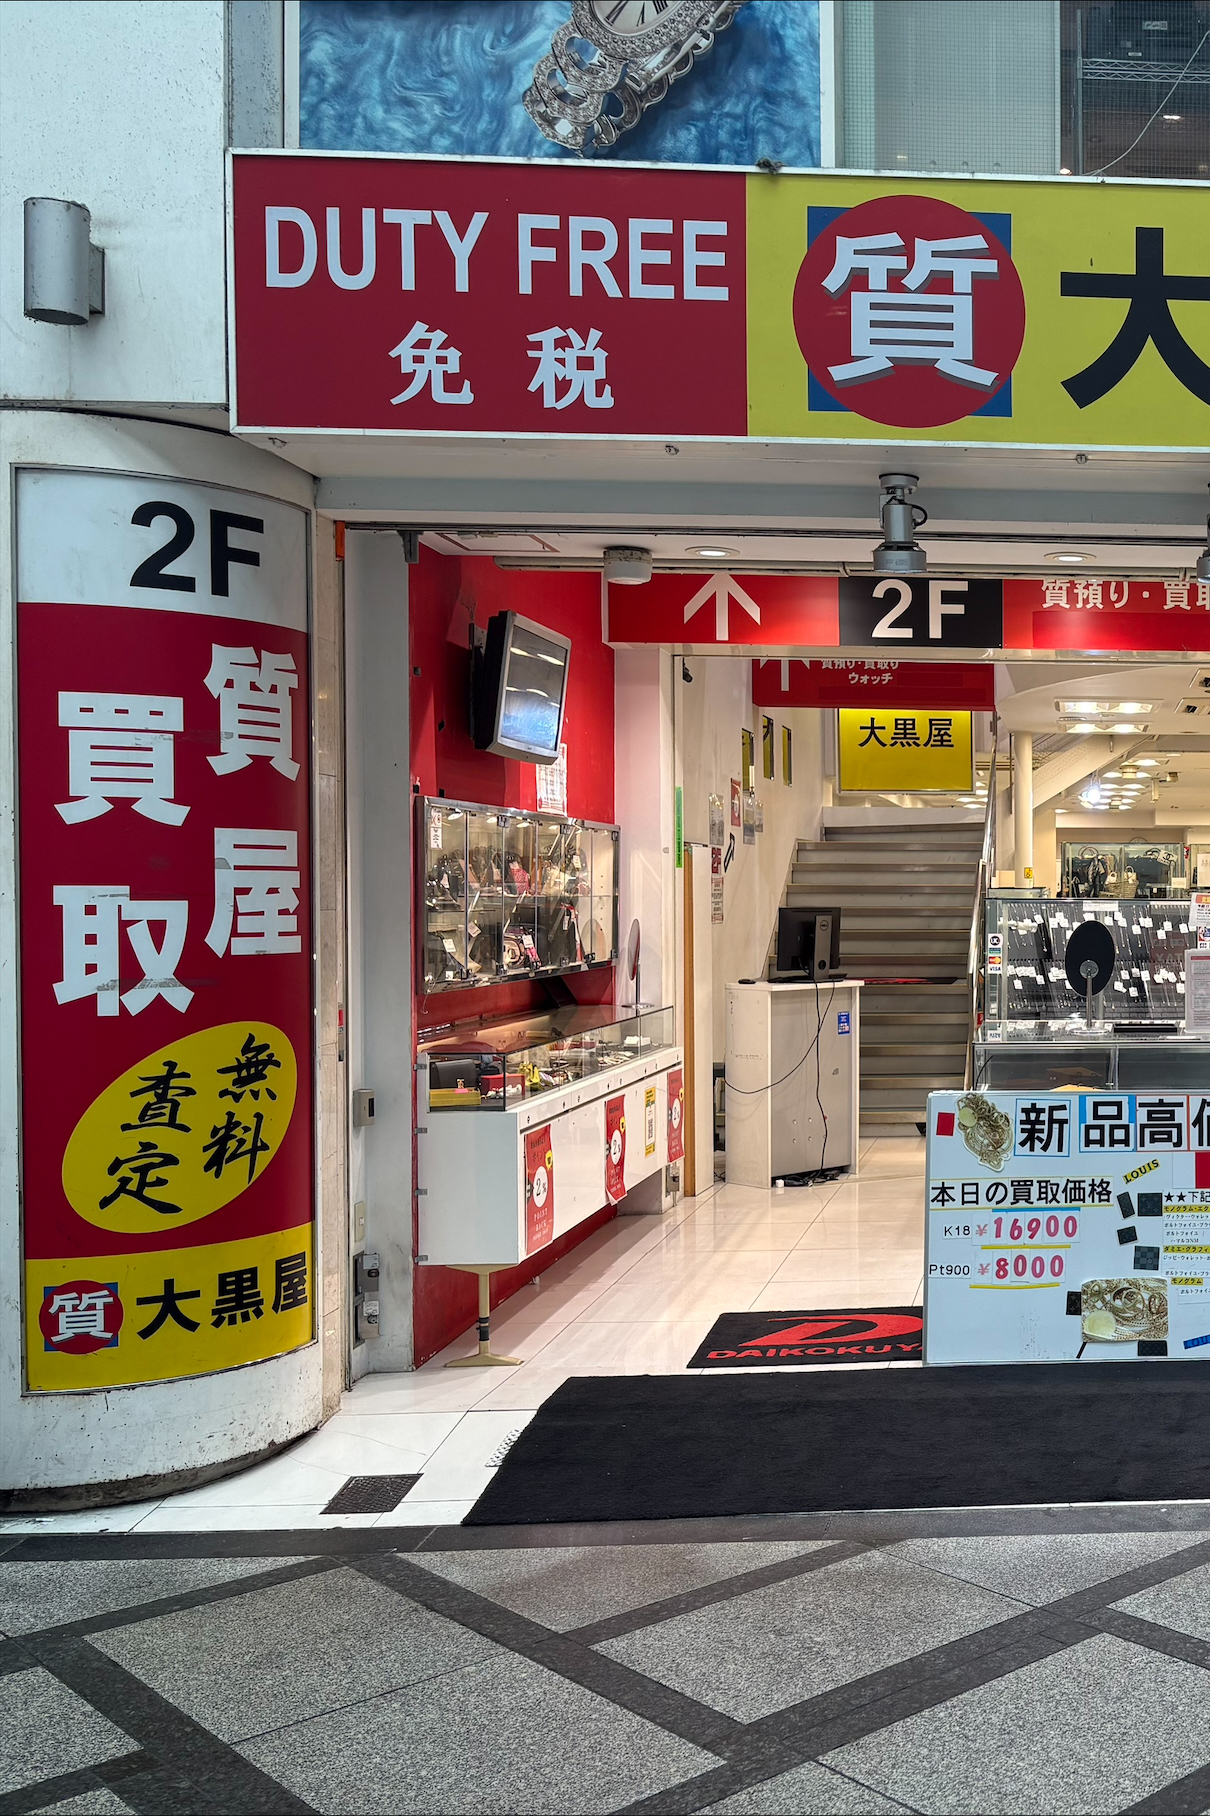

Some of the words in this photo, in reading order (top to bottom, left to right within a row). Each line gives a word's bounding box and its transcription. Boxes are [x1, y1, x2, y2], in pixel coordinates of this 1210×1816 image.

[264, 205, 489, 293] DUTY
[517, 212, 730, 302] FREE
[820, 231, 1000, 388] 質
[388, 319, 614, 411] 免税
[130, 500, 265, 598] 2F
[870, 579, 969, 640] 2F
[849, 672, 893, 685] ウォッチ
[858, 717, 955, 748] 大黒屋
[203, 643, 302, 959] 質屋
[52, 691, 195, 1017] 買取
[98, 1060, 197, 1215] 査定
[202, 1032, 282, 1185] 無料
[930, 1178, 1113, 1207] 本日の買取価格
[1124, 1158, 1159, 1185] LOUIS
[929, 1264, 970, 1277] Pt900
[944, 1225, 971, 1237] K18
[48, 1290, 115, 1344] 質
[136, 1251, 308, 1341] 大黒屋
